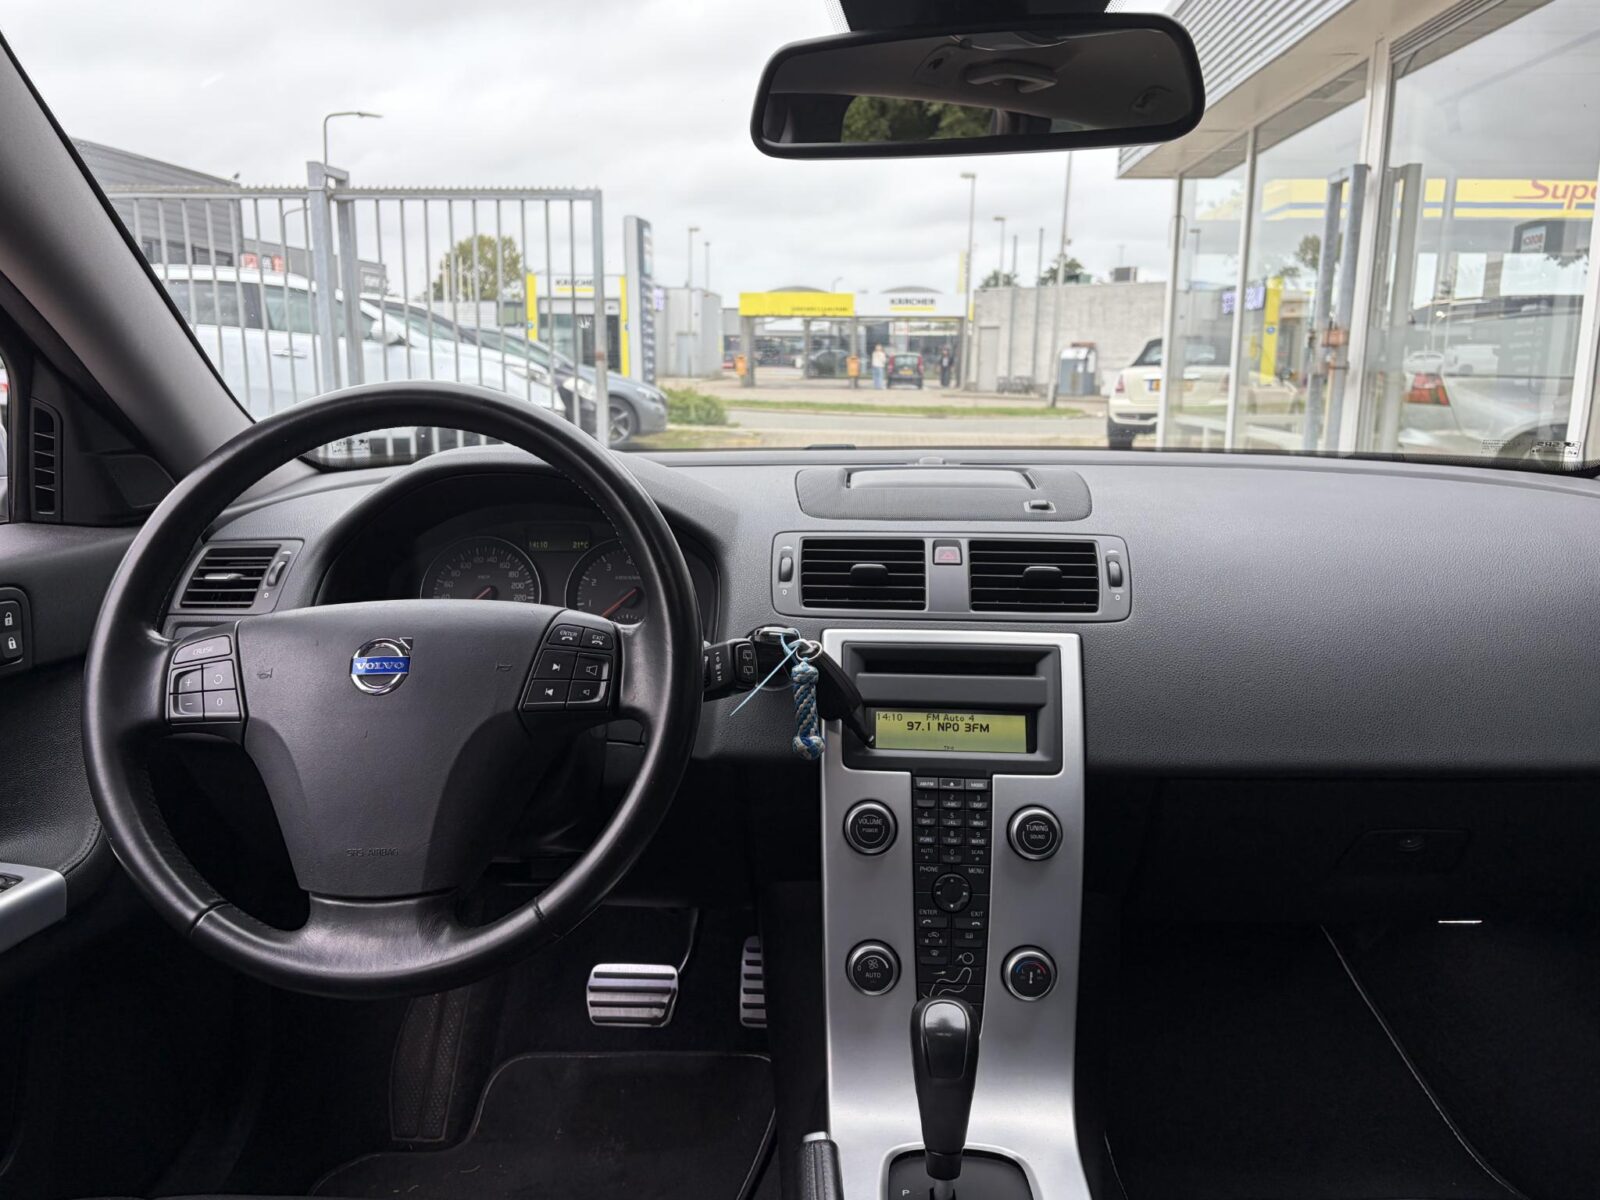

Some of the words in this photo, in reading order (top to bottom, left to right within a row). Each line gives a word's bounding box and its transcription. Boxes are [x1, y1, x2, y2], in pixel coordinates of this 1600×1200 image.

[511, 581, 525, 590] 200
[513, 594, 527, 602] 220
[560, 629, 578, 637] ENTER
[355, 661, 405, 671] VOLVO
[876, 713, 903, 721] 14:10
[926, 713, 940, 721] FM
[943, 714, 965, 722] Auto
[968, 714, 975, 722] 4
[906, 721, 931, 731] 97.1
[937, 722, 960, 732] NPO
[964, 723, 990, 733] 3FM
[1026, 824, 1049, 832] TUNING
[920, 865, 939, 873] PHONE
[902, 1189, 910, 1197] P
